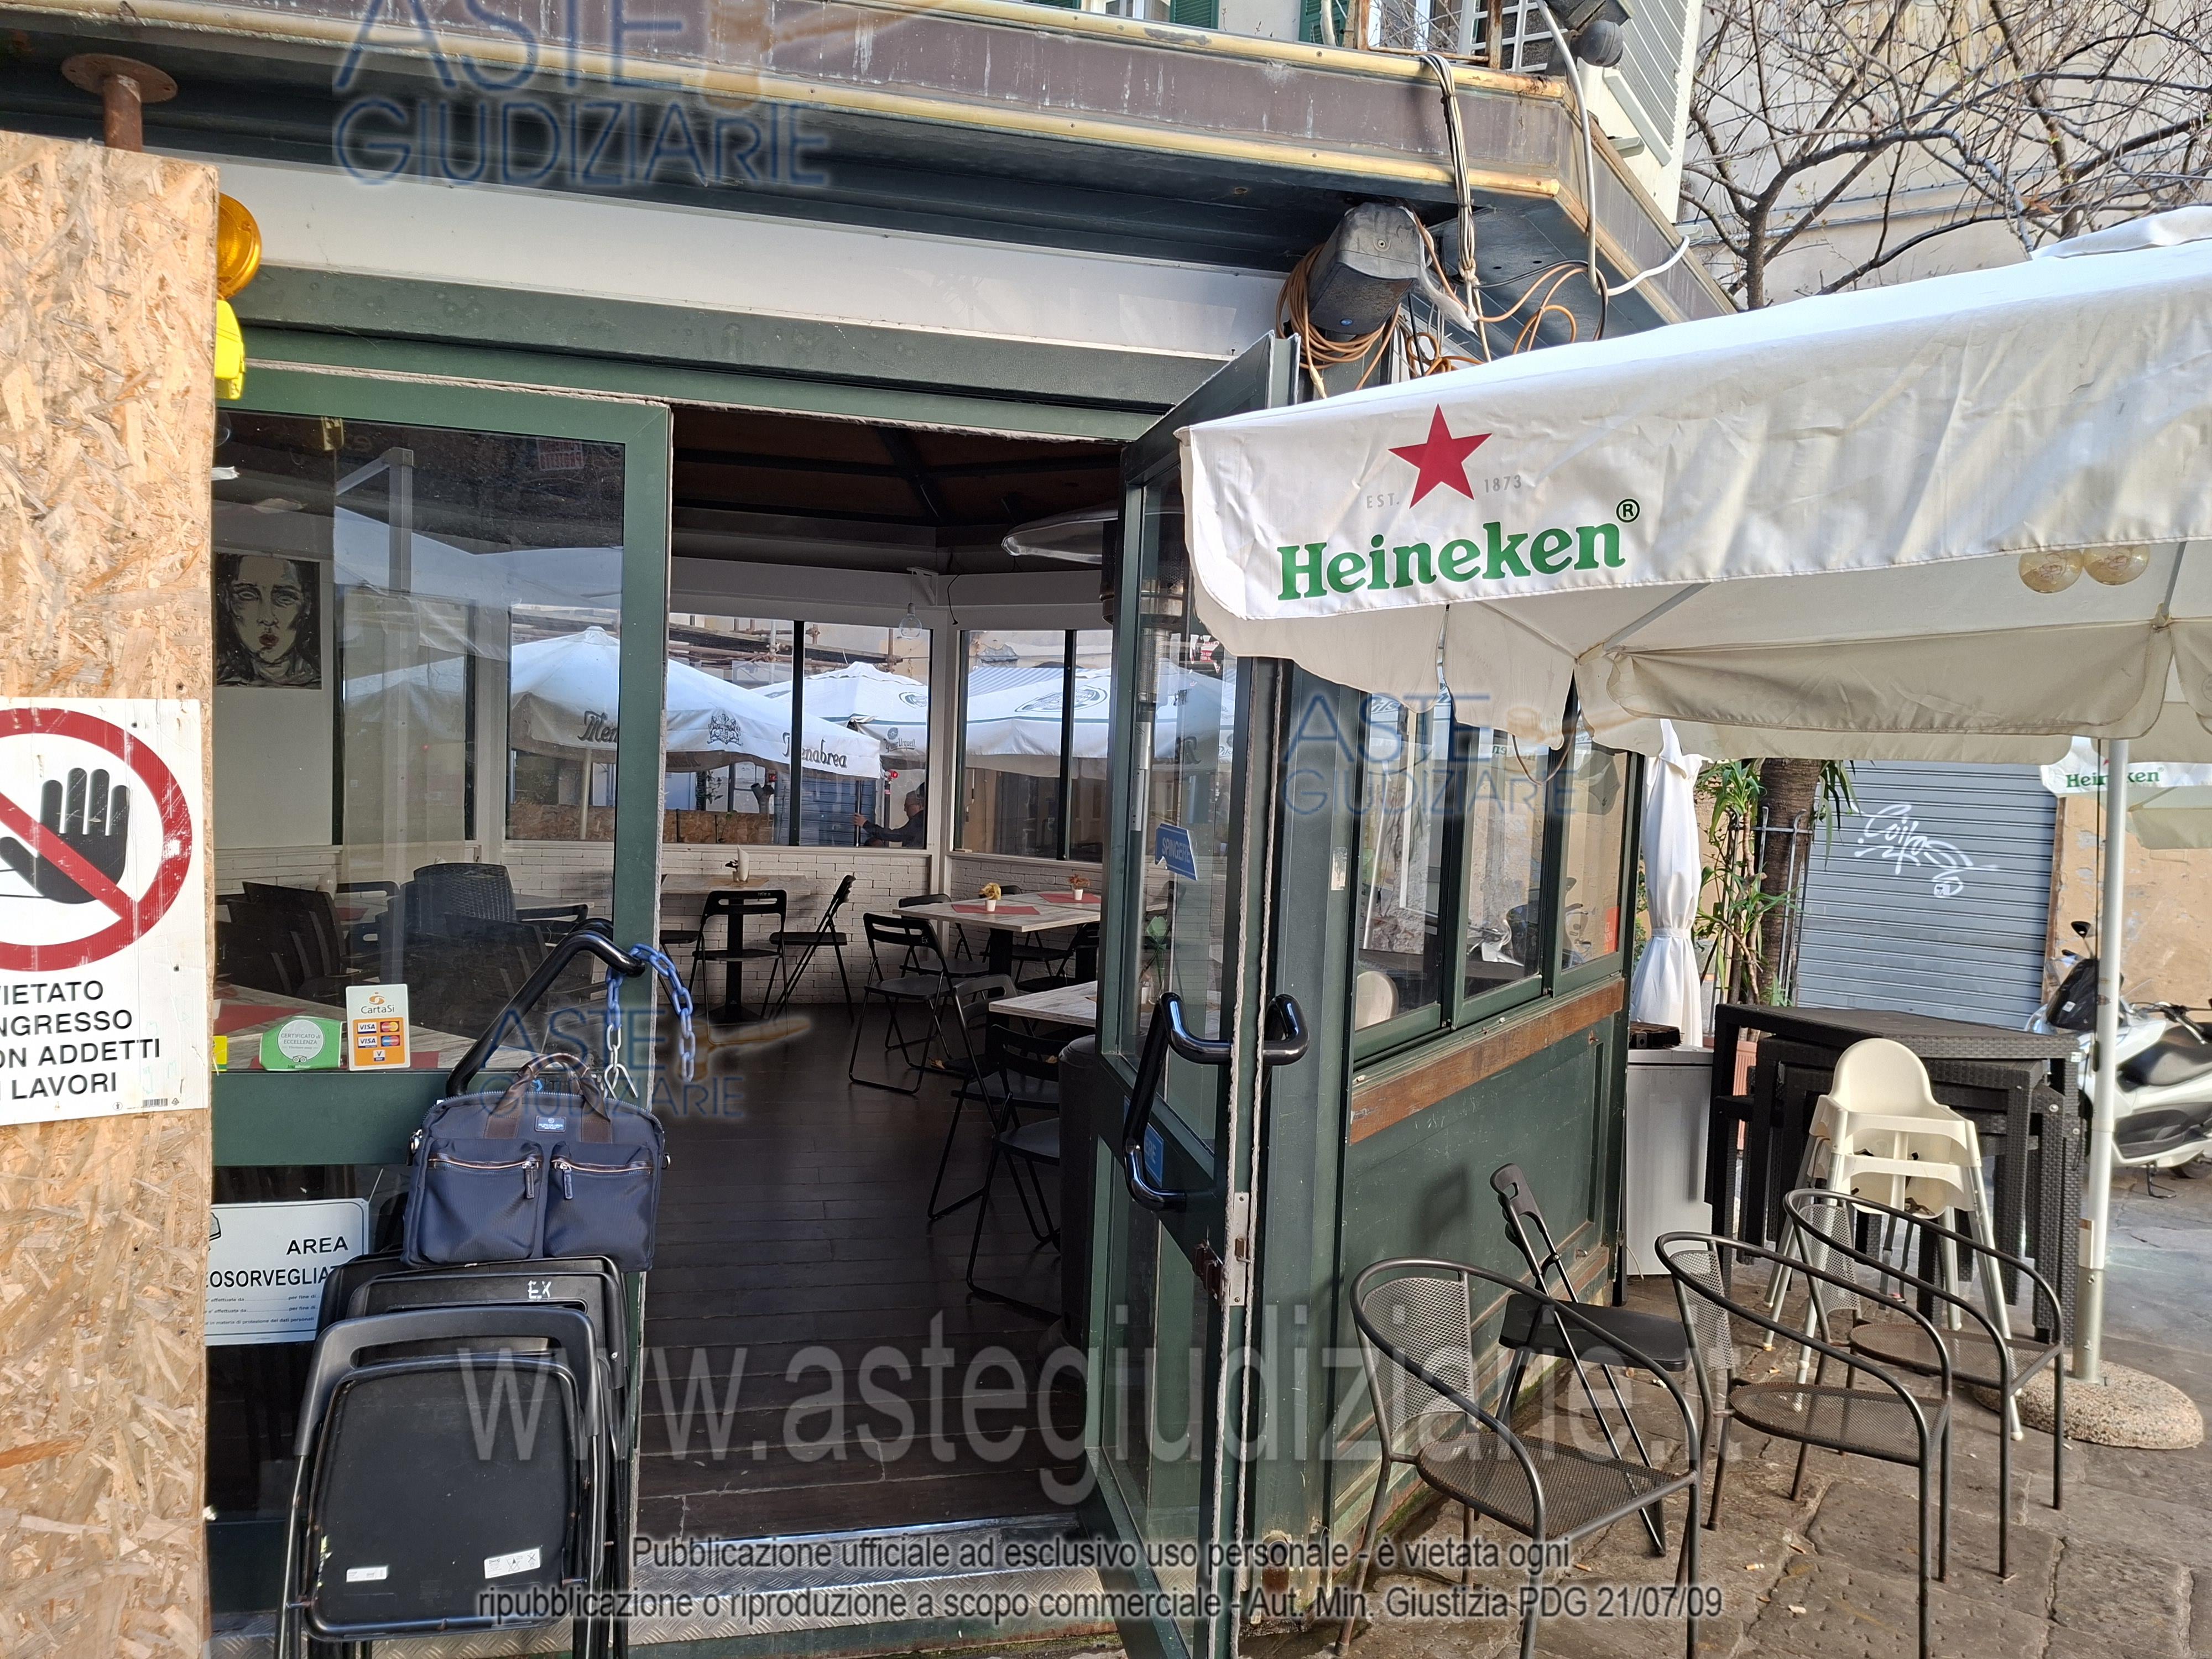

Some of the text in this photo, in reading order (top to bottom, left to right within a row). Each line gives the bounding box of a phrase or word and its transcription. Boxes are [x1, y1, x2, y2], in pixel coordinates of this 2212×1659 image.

[1366, 474, 1522, 509] EST. 1873
[1162, 837, 1191, 863] SPINGERE
[0, 980, 103, 1005] IETATO
[361, 1004, 394, 1014] CartaSi
[38, 1038, 160, 1066] ADDETTI
[12, 1072, 116, 1100] LAVORI
[286, 1236, 348, 1255] AREA
[206, 1266, 338, 1288] OSORVEGLIA
[528, 1280, 551, 1299] EX
